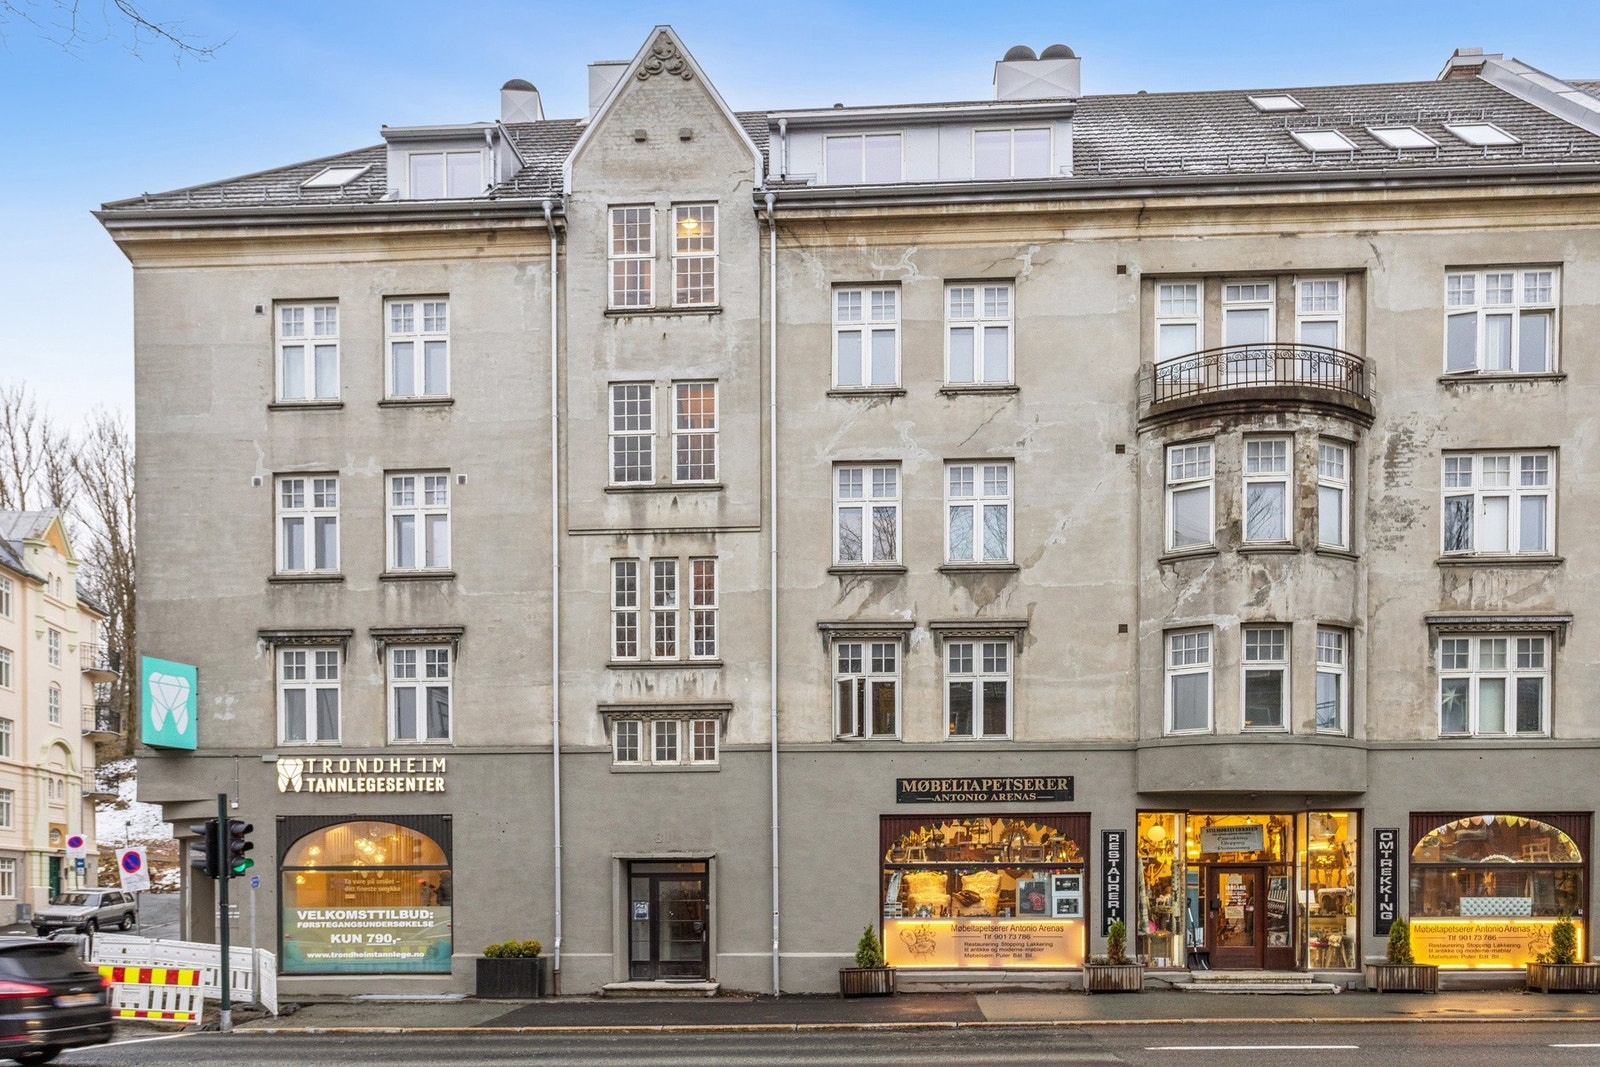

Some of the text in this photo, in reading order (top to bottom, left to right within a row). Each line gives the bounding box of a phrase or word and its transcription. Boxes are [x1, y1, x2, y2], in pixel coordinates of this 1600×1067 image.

[306, 757, 446, 773] TRONDHEIM
[306, 777, 446, 792] TANNLEGESENTER
[901, 778, 1068, 792] MØBELTAPETSERER
[934, 792, 1037, 802] ANTONIO ARENAS
[1379, 832, 1394, 920] OMTREKKING
[1107, 833, 1121, 933] RESTAURERIN
[297, 910, 434, 920] VELKOMSTTILBUD:
[951, 924, 1064, 933] Møbeltapetserer Antonio Arenas
[1414, 925, 1531, 934] Møbeltapetserer Antonio Arenas
[330, 933, 401, 945] KUN 790,-
[307, 951, 425, 959] www.trondheimtannlege.no
